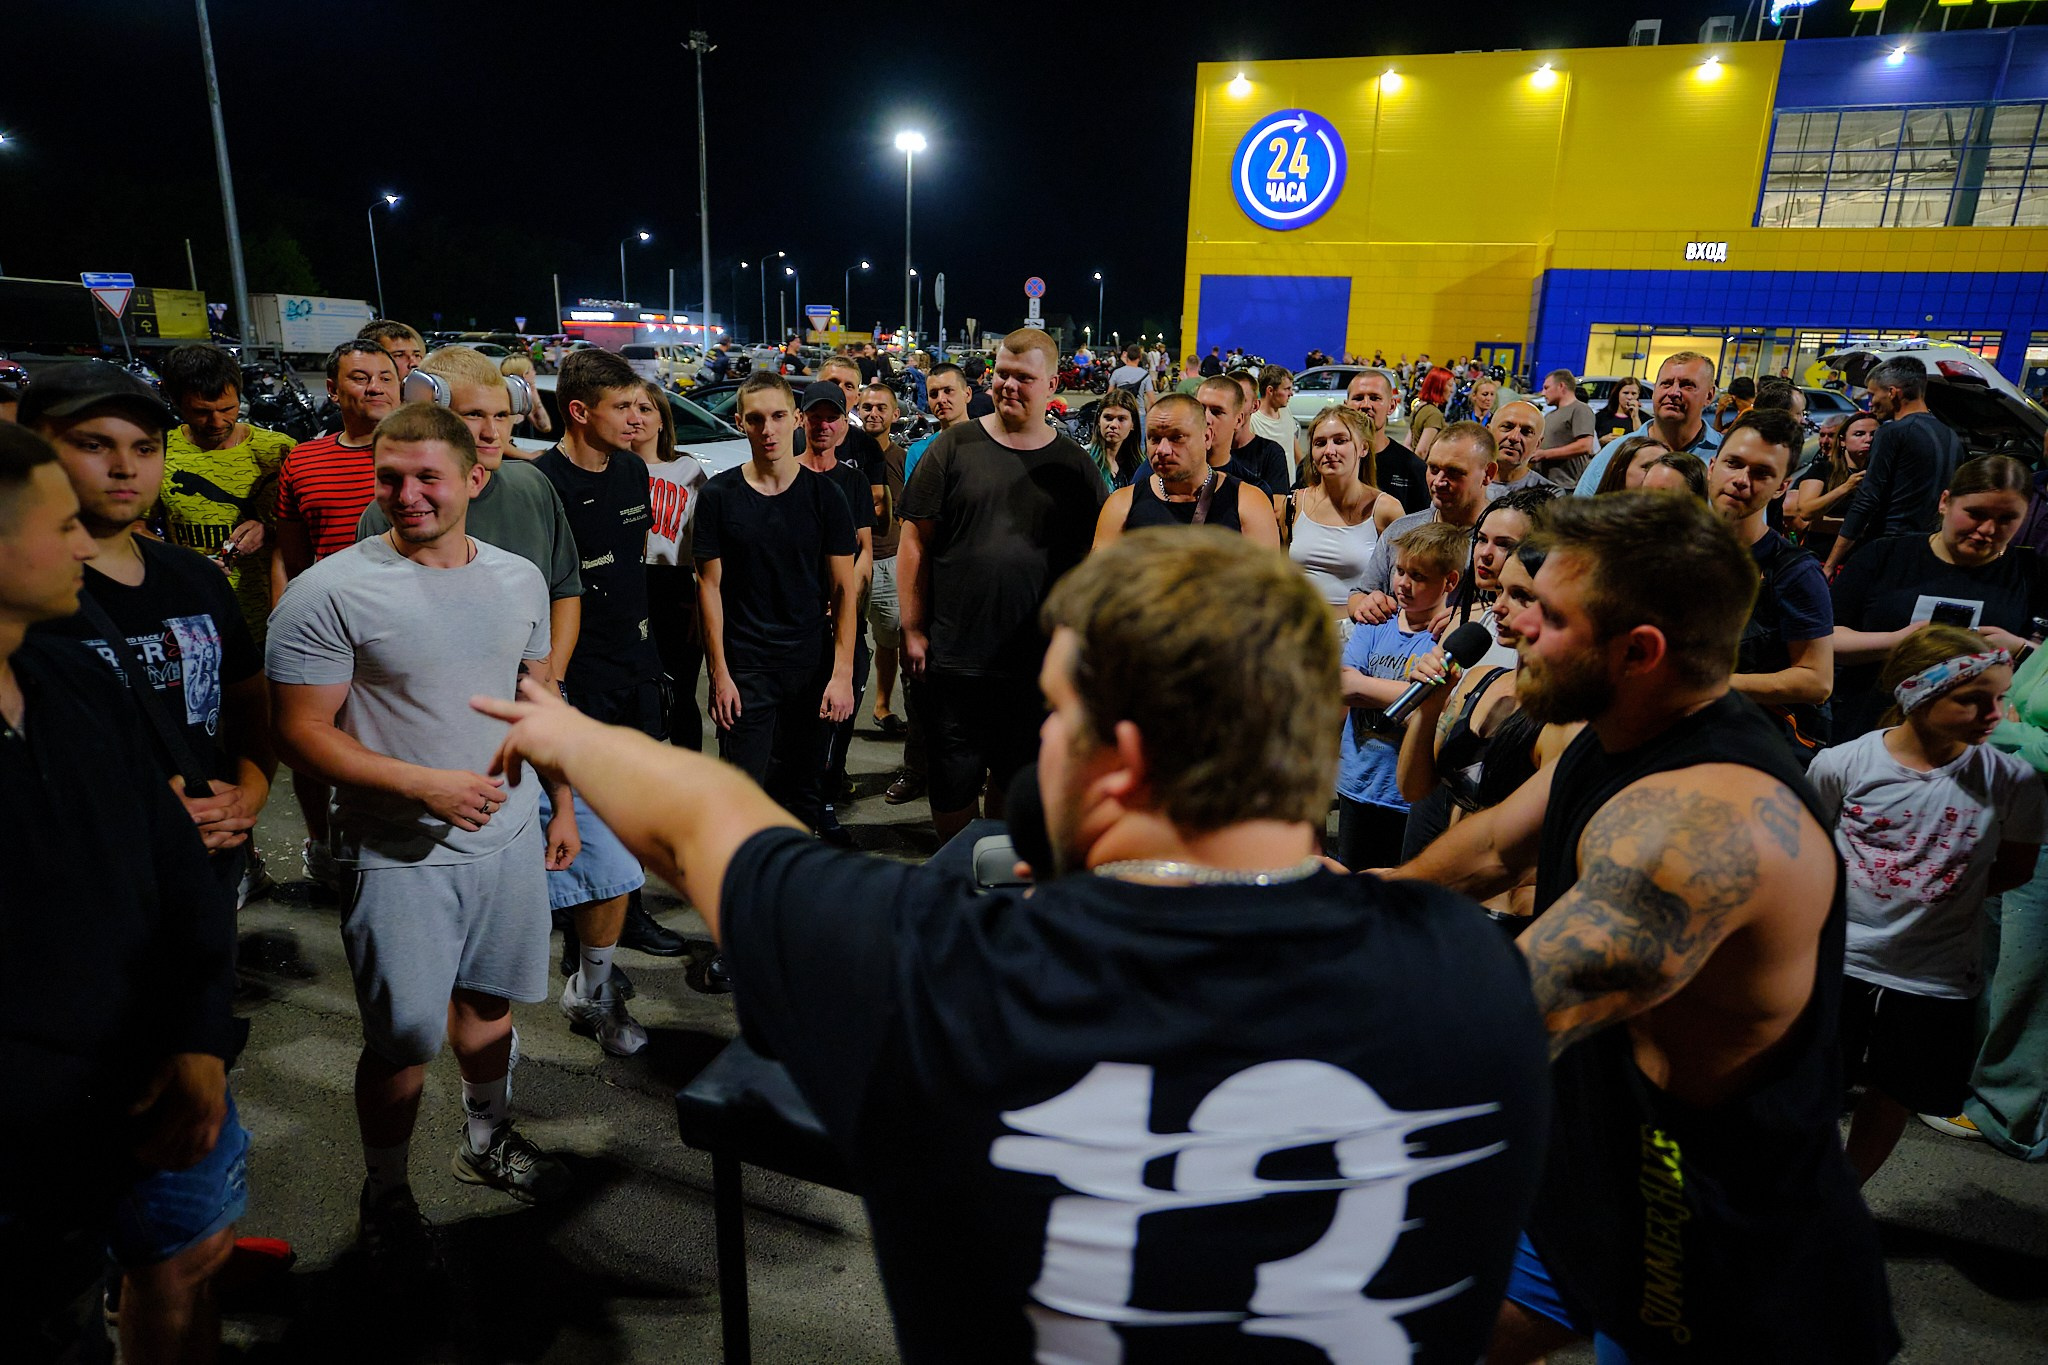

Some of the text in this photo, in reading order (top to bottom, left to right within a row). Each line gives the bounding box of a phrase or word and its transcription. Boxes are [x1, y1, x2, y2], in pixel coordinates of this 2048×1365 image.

[1267, 137, 1310, 179] 24
[1266, 181, 1307, 202] ЧАСА
[1685, 242, 1727, 263] ВХОД
